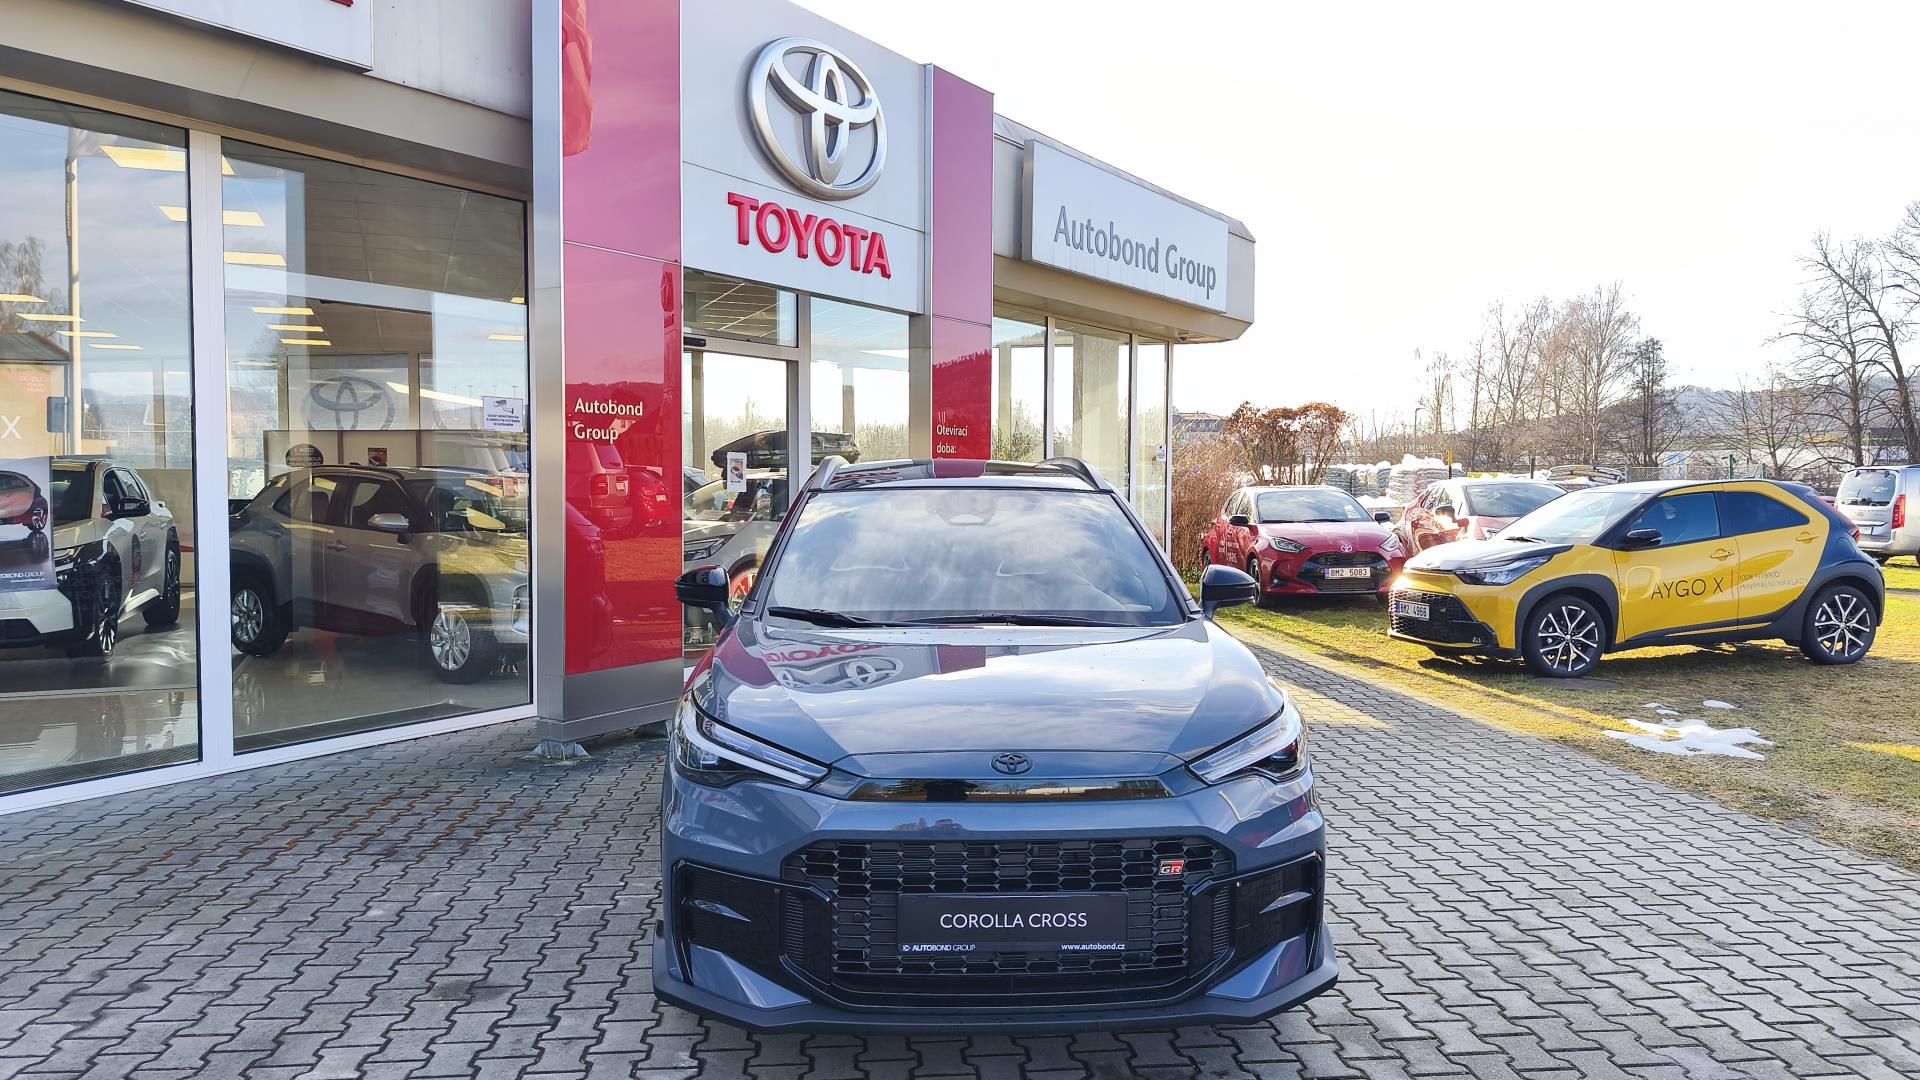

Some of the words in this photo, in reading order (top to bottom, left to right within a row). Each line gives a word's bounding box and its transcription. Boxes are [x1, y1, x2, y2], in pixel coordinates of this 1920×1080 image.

[727, 192, 892, 279] TOYOTA
[1053, 205, 1159, 273] Autobond
[1165, 244, 1217, 299] Group
[574, 397, 643, 416] Autobond
[574, 422, 619, 444] Group
[936, 424, 968, 437] Otevírací
[936, 442, 957, 454] doba:
[1650, 578, 1707, 600] AYGO
[1712, 577, 1725, 595] X
[1160, 865, 1183, 874] GR
[940, 913, 1025, 929] COROLLA
[1028, 912, 1088, 928] CROSS
[952, 943, 976, 951] GROUP
[1061, 942, 1126, 950] www.autobond.cz
